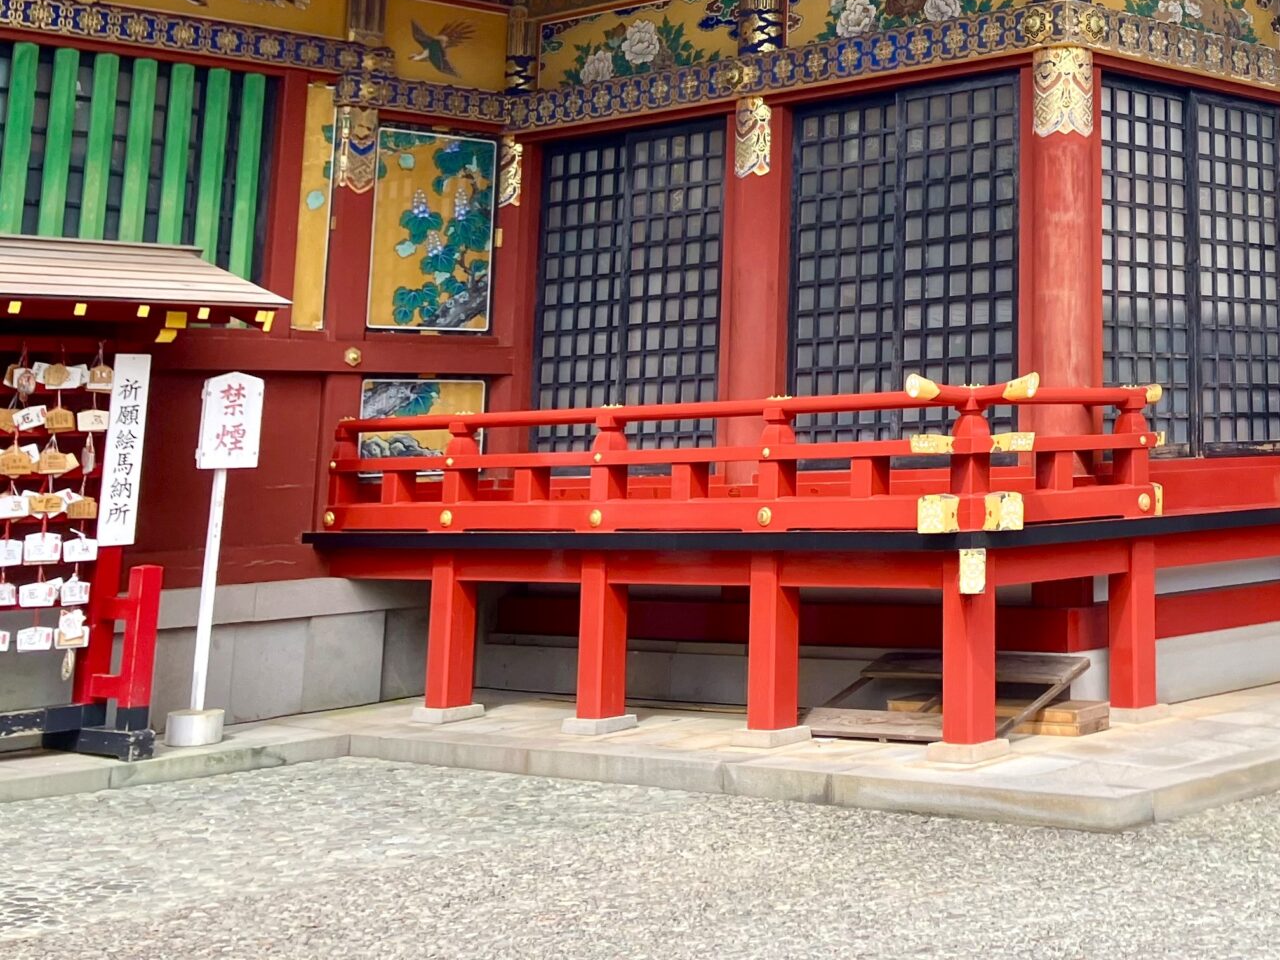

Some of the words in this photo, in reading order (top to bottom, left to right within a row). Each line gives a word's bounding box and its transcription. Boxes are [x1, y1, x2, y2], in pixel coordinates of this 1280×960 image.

[106, 378, 142, 525] 祈願絵馬納所
[214, 383, 247, 452] 禁煙
